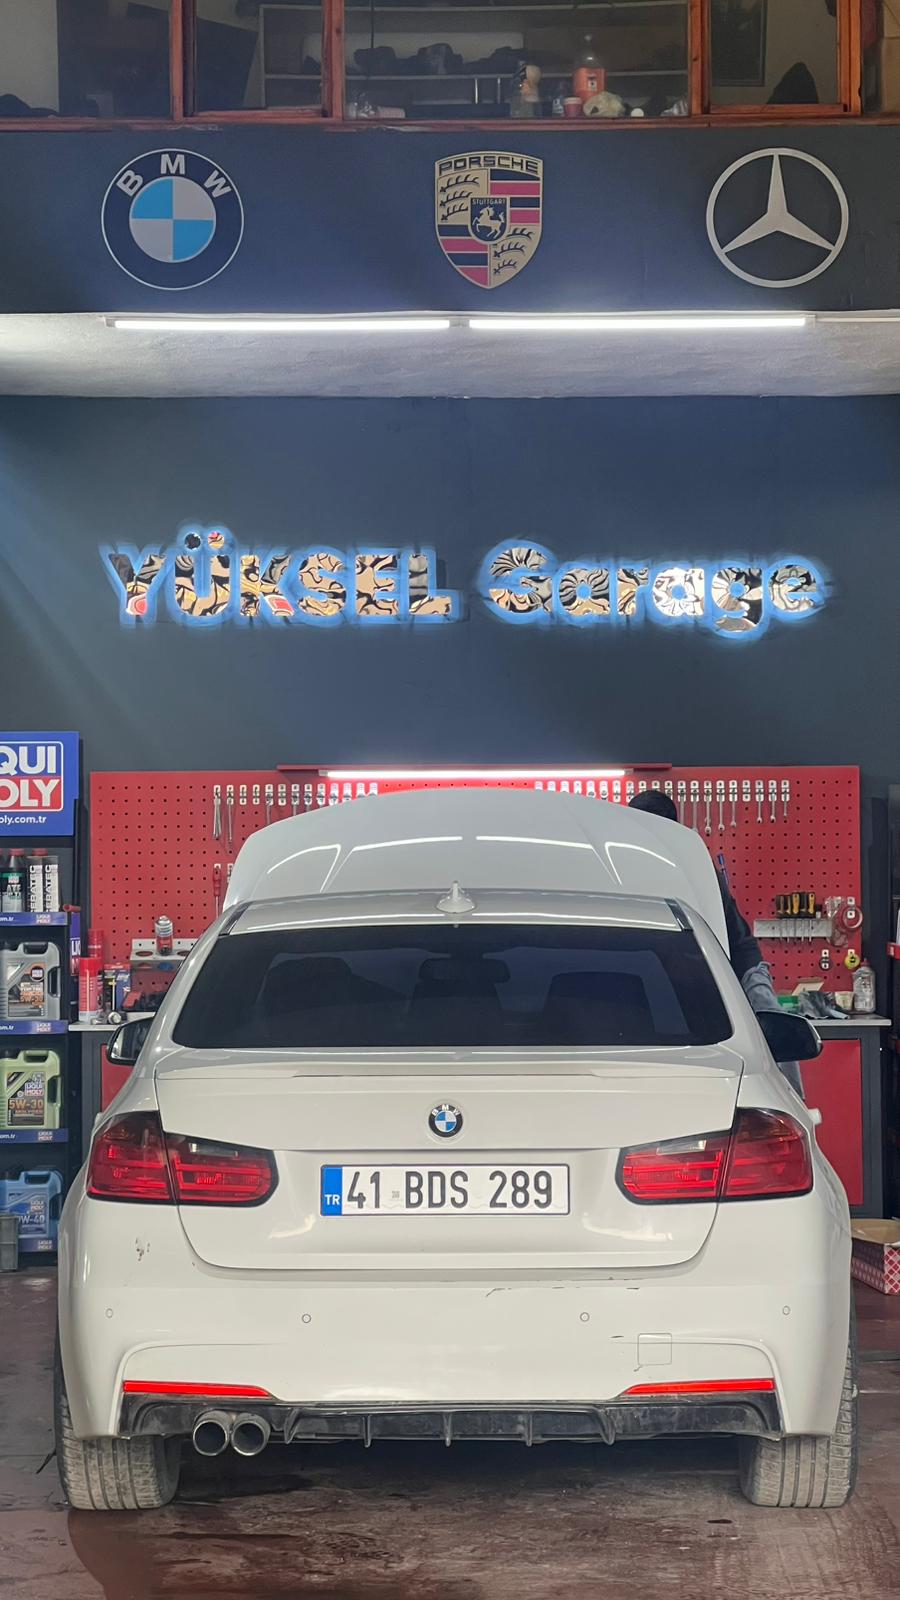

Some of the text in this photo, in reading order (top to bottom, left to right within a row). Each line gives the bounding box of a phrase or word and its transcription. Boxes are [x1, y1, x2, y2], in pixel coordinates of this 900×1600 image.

[116, 153, 232, 198] BMW
[440, 155, 539, 176] PORSCHE
[108, 531, 818, 633] YÜKSEL Garage
[9, 1099, 44, 1109] 5W-30
[431, 1104, 461, 1116] BMW
[325, 1170, 552, 1209] TR 41 BDS 289
